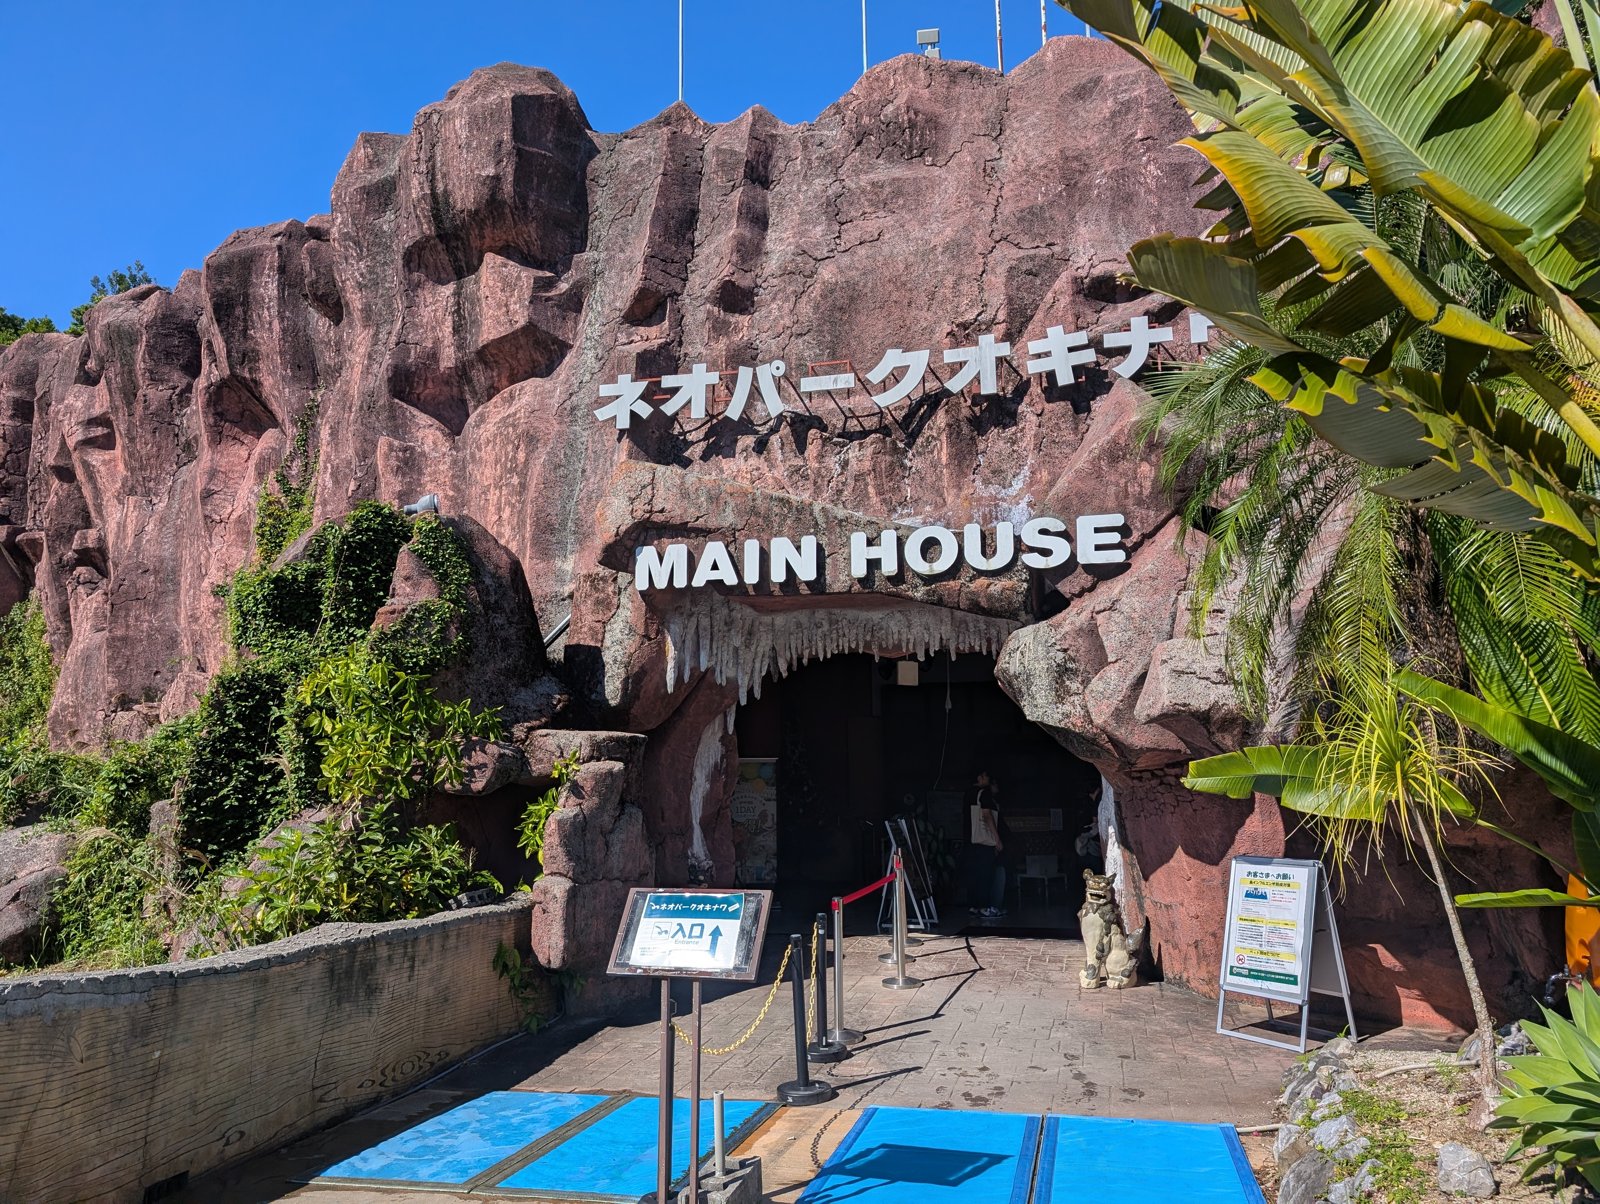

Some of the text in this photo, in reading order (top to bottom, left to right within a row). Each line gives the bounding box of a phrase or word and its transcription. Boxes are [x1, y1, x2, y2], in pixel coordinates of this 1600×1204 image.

[635, 513, 1126, 591] MAIN HOUSE
[660, 903, 728, 912] ネオパークオキナワ
[671, 923, 705, 940] 入口
